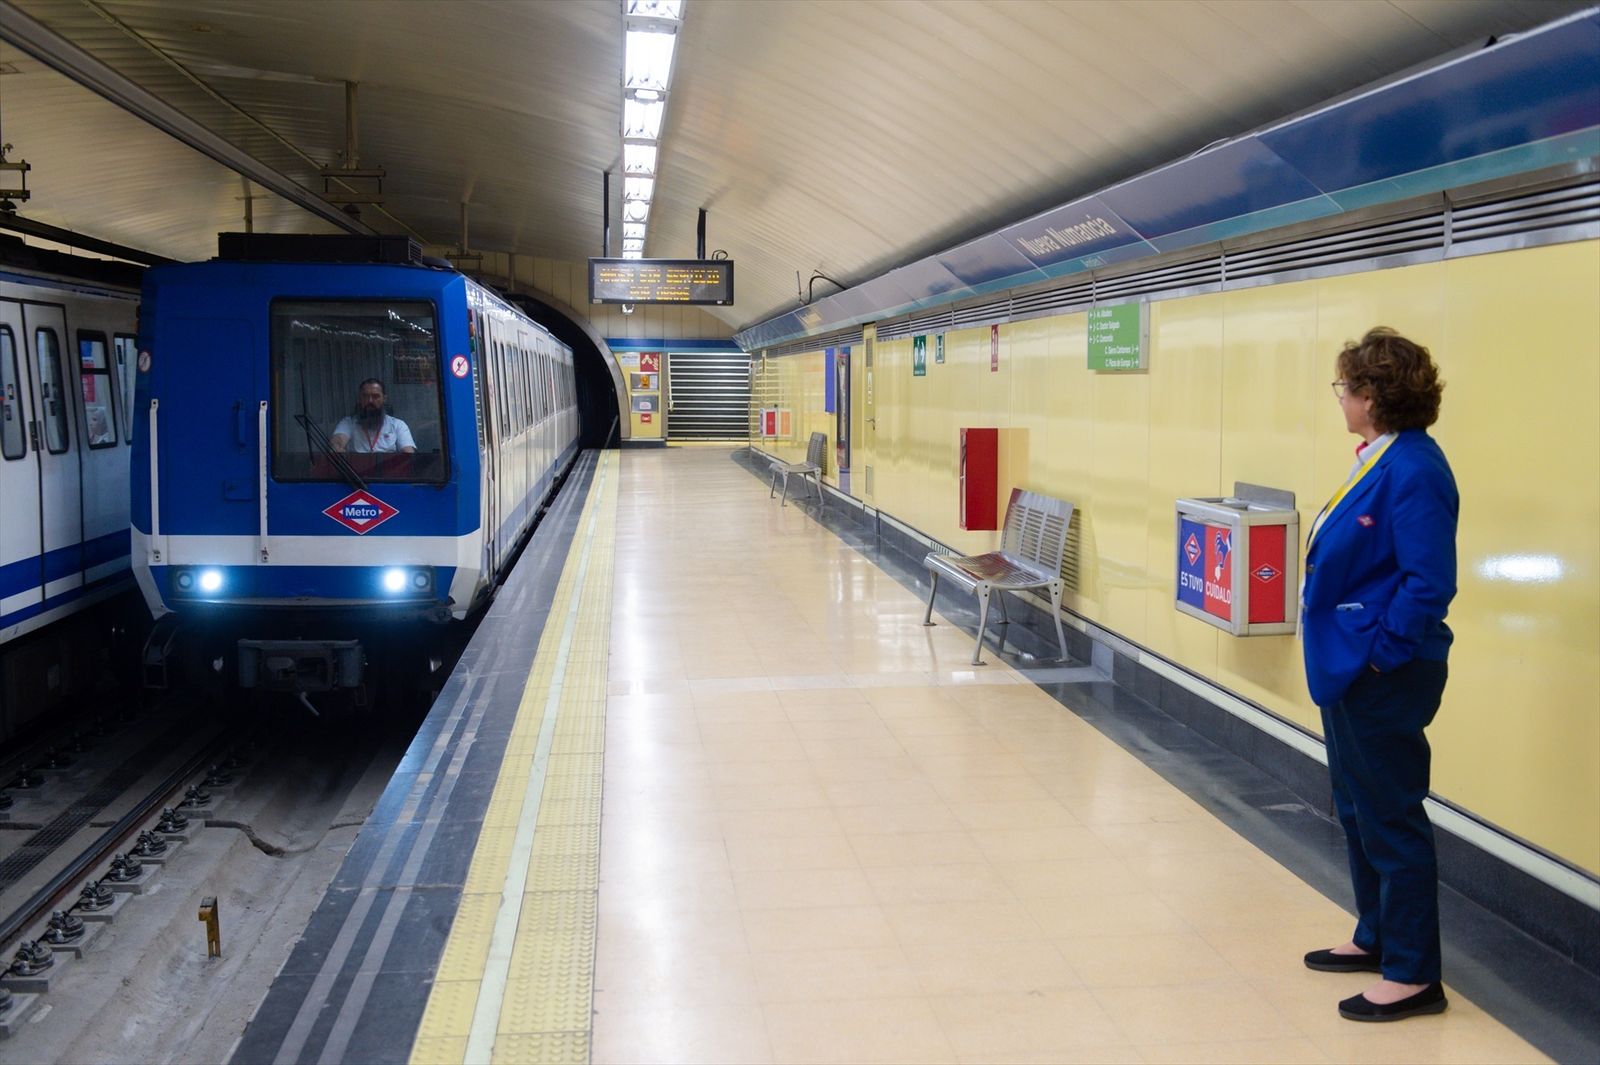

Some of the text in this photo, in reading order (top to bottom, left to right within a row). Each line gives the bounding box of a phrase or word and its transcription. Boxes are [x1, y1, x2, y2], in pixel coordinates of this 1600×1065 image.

[1016, 214, 1117, 256] Nueva Numancia
[345, 507, 377, 517] Metro
[1181, 571, 1203, 593] ES TUYO
[1206, 580, 1231, 604] CUÍDALO
